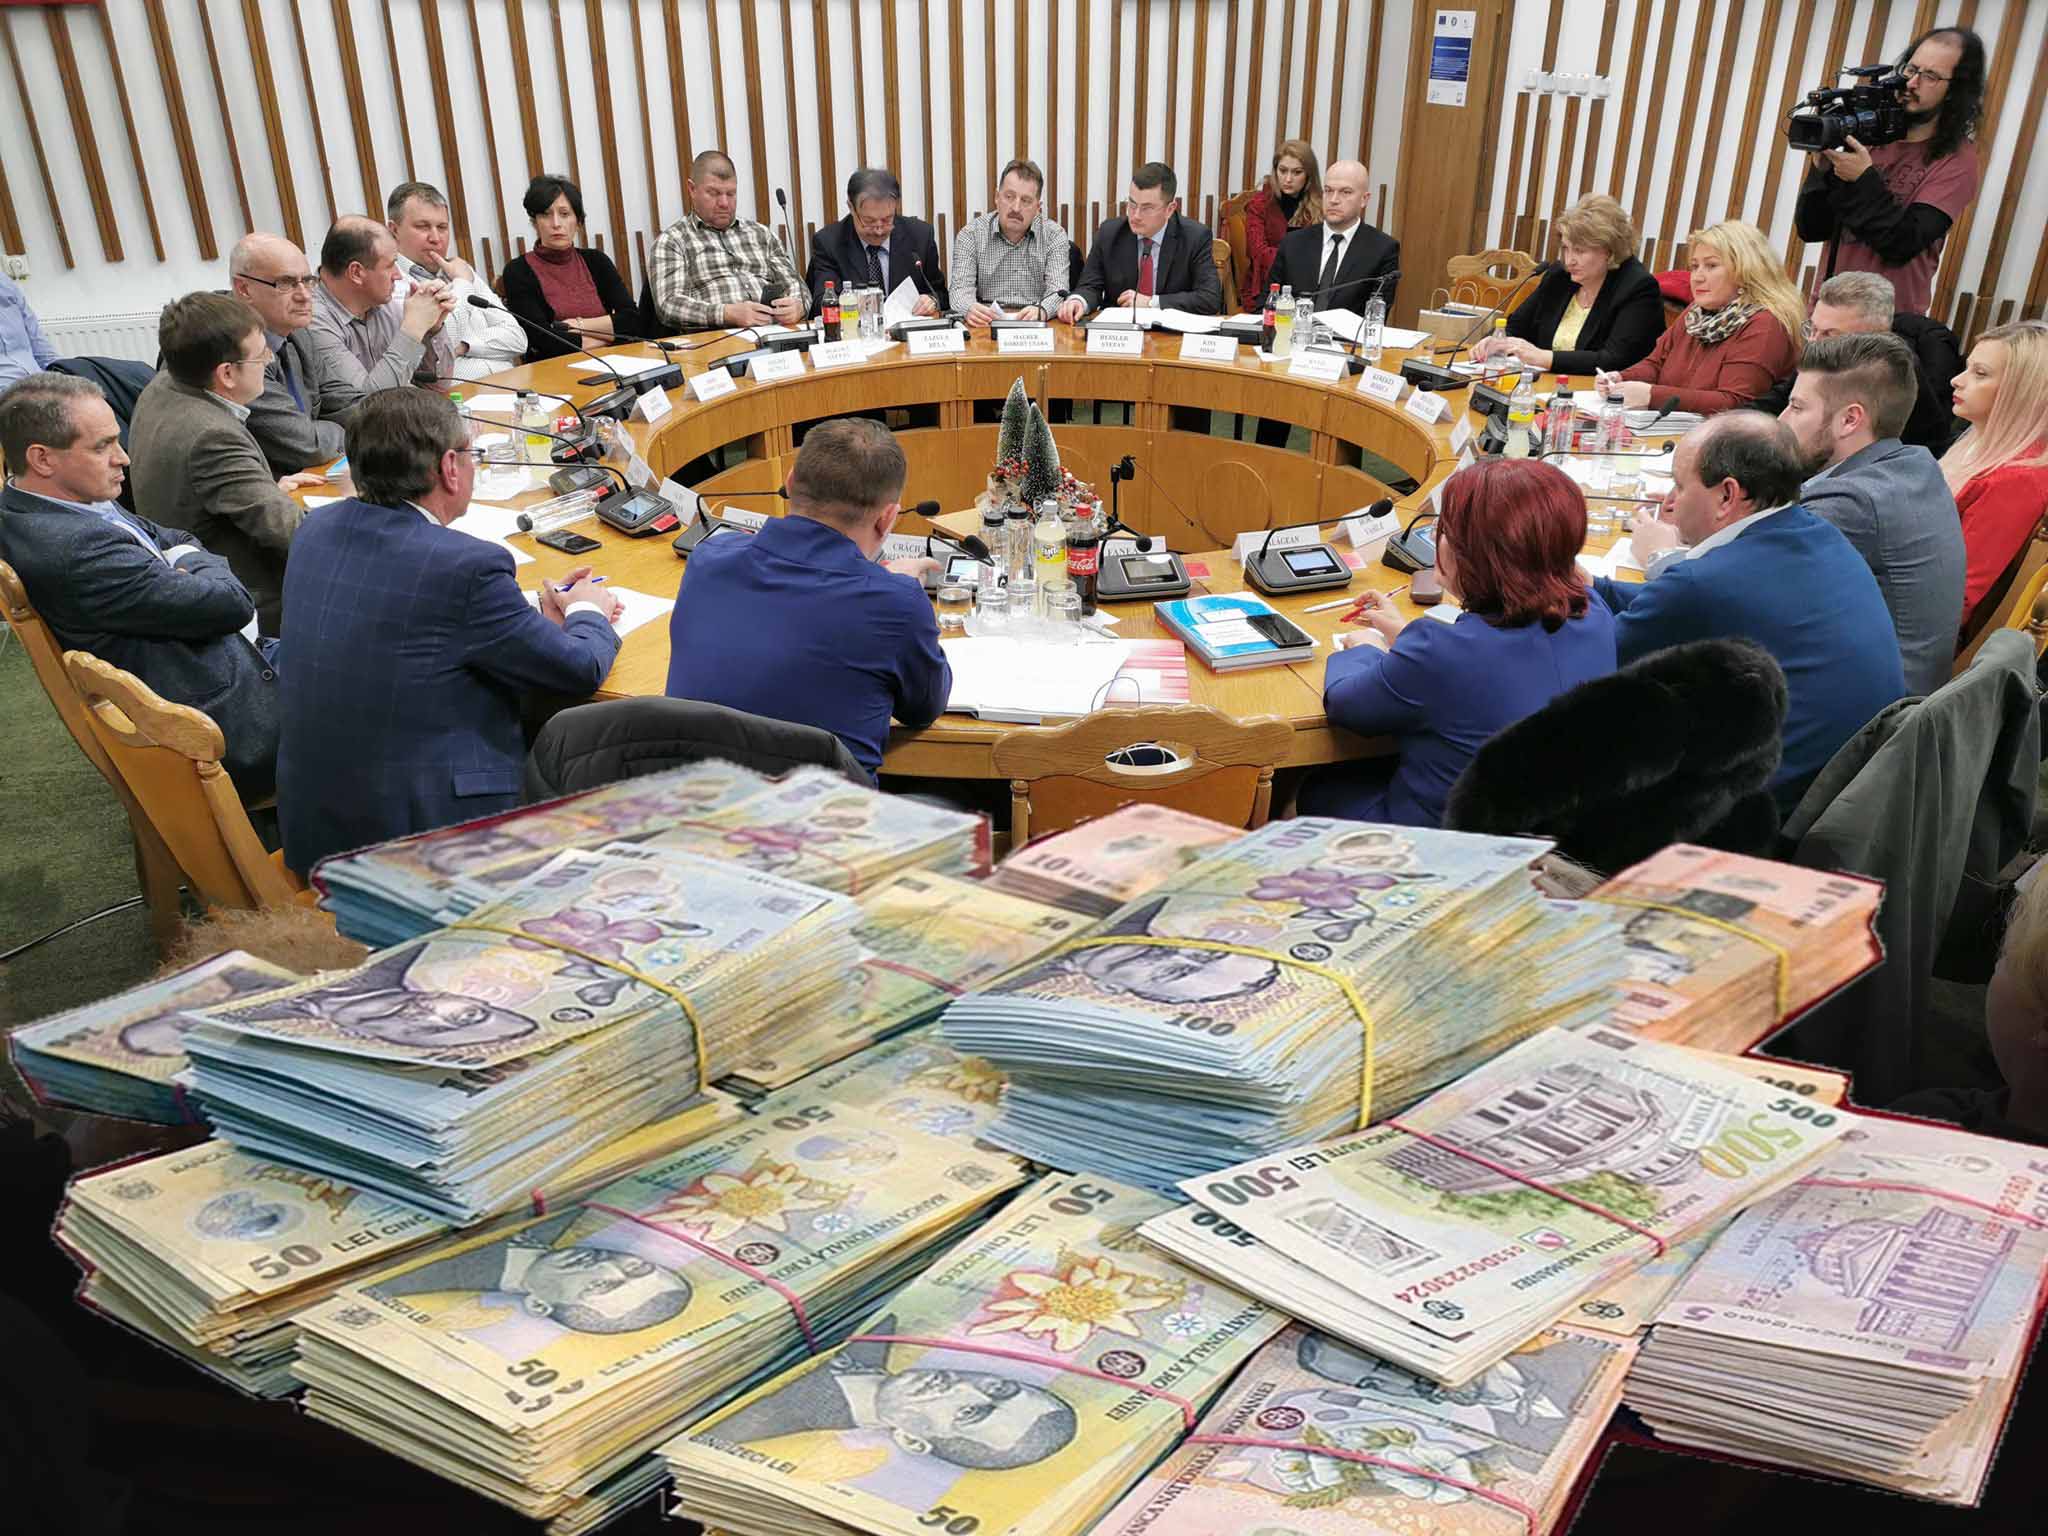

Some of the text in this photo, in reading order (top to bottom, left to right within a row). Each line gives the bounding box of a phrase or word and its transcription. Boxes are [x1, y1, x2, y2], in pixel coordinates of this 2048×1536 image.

[1025, 853, 1072, 871] 10
[1031, 916, 1071, 931] 50
[1165, 1011, 1237, 1037] 100
[771, 1103, 836, 1131] 50
[1767, 1098, 1837, 1129] 500
[724, 1128, 768, 1148] LEI
[1699, 1113, 1803, 1180] 500
[1206, 1166, 1300, 1206] 500
[1287, 1151, 1331, 1172] LEI
[1048, 1183, 1116, 1216] 50
[1008, 1214, 1050, 1238] LEI
[248, 1244, 323, 1280] 50
[331, 1229, 381, 1254] LEI
[1682, 1305, 1716, 1322] 5
[506, 1358, 560, 1388] 50
[767, 1458, 799, 1475] LEI
[916, 1505, 981, 1536] 50
